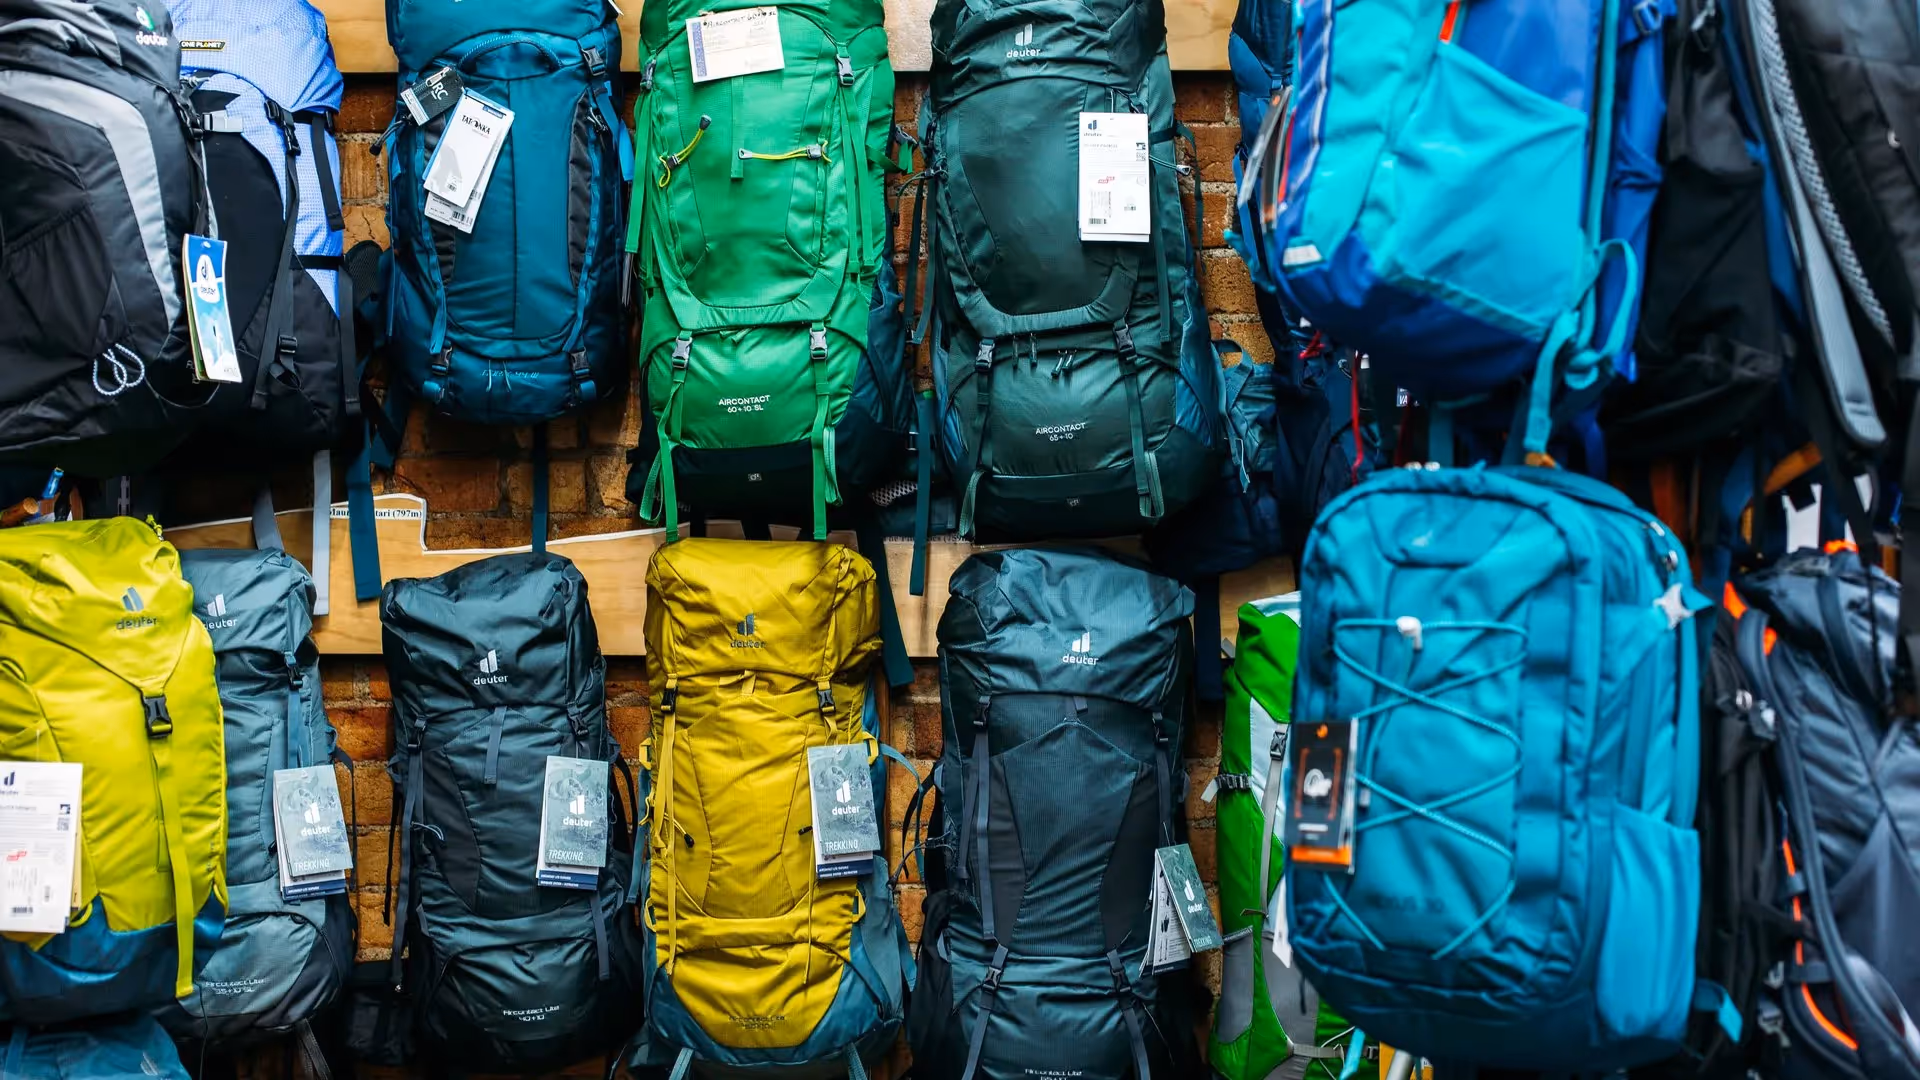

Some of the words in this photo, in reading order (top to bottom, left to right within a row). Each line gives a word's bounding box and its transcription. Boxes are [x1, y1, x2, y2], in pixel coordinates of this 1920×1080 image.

[1006, 48, 1040, 58] deuter
[718, 394, 771, 406] AIRCONTACT
[1035, 422, 1086, 435] AIRCONTACT
[116, 616, 158, 630] deuter
[731, 639, 768, 648] deuter
[1062, 653, 1099, 665] deuter
[473, 675, 508, 685] deuter
[832, 804, 860, 816] deuter
[563, 816, 593, 827] deuter
[300, 825, 331, 837] deuter
[825, 839, 859, 852] TREKKING
[548, 849, 584, 861] TREKKING
[294, 858, 330, 872] TREKKING
